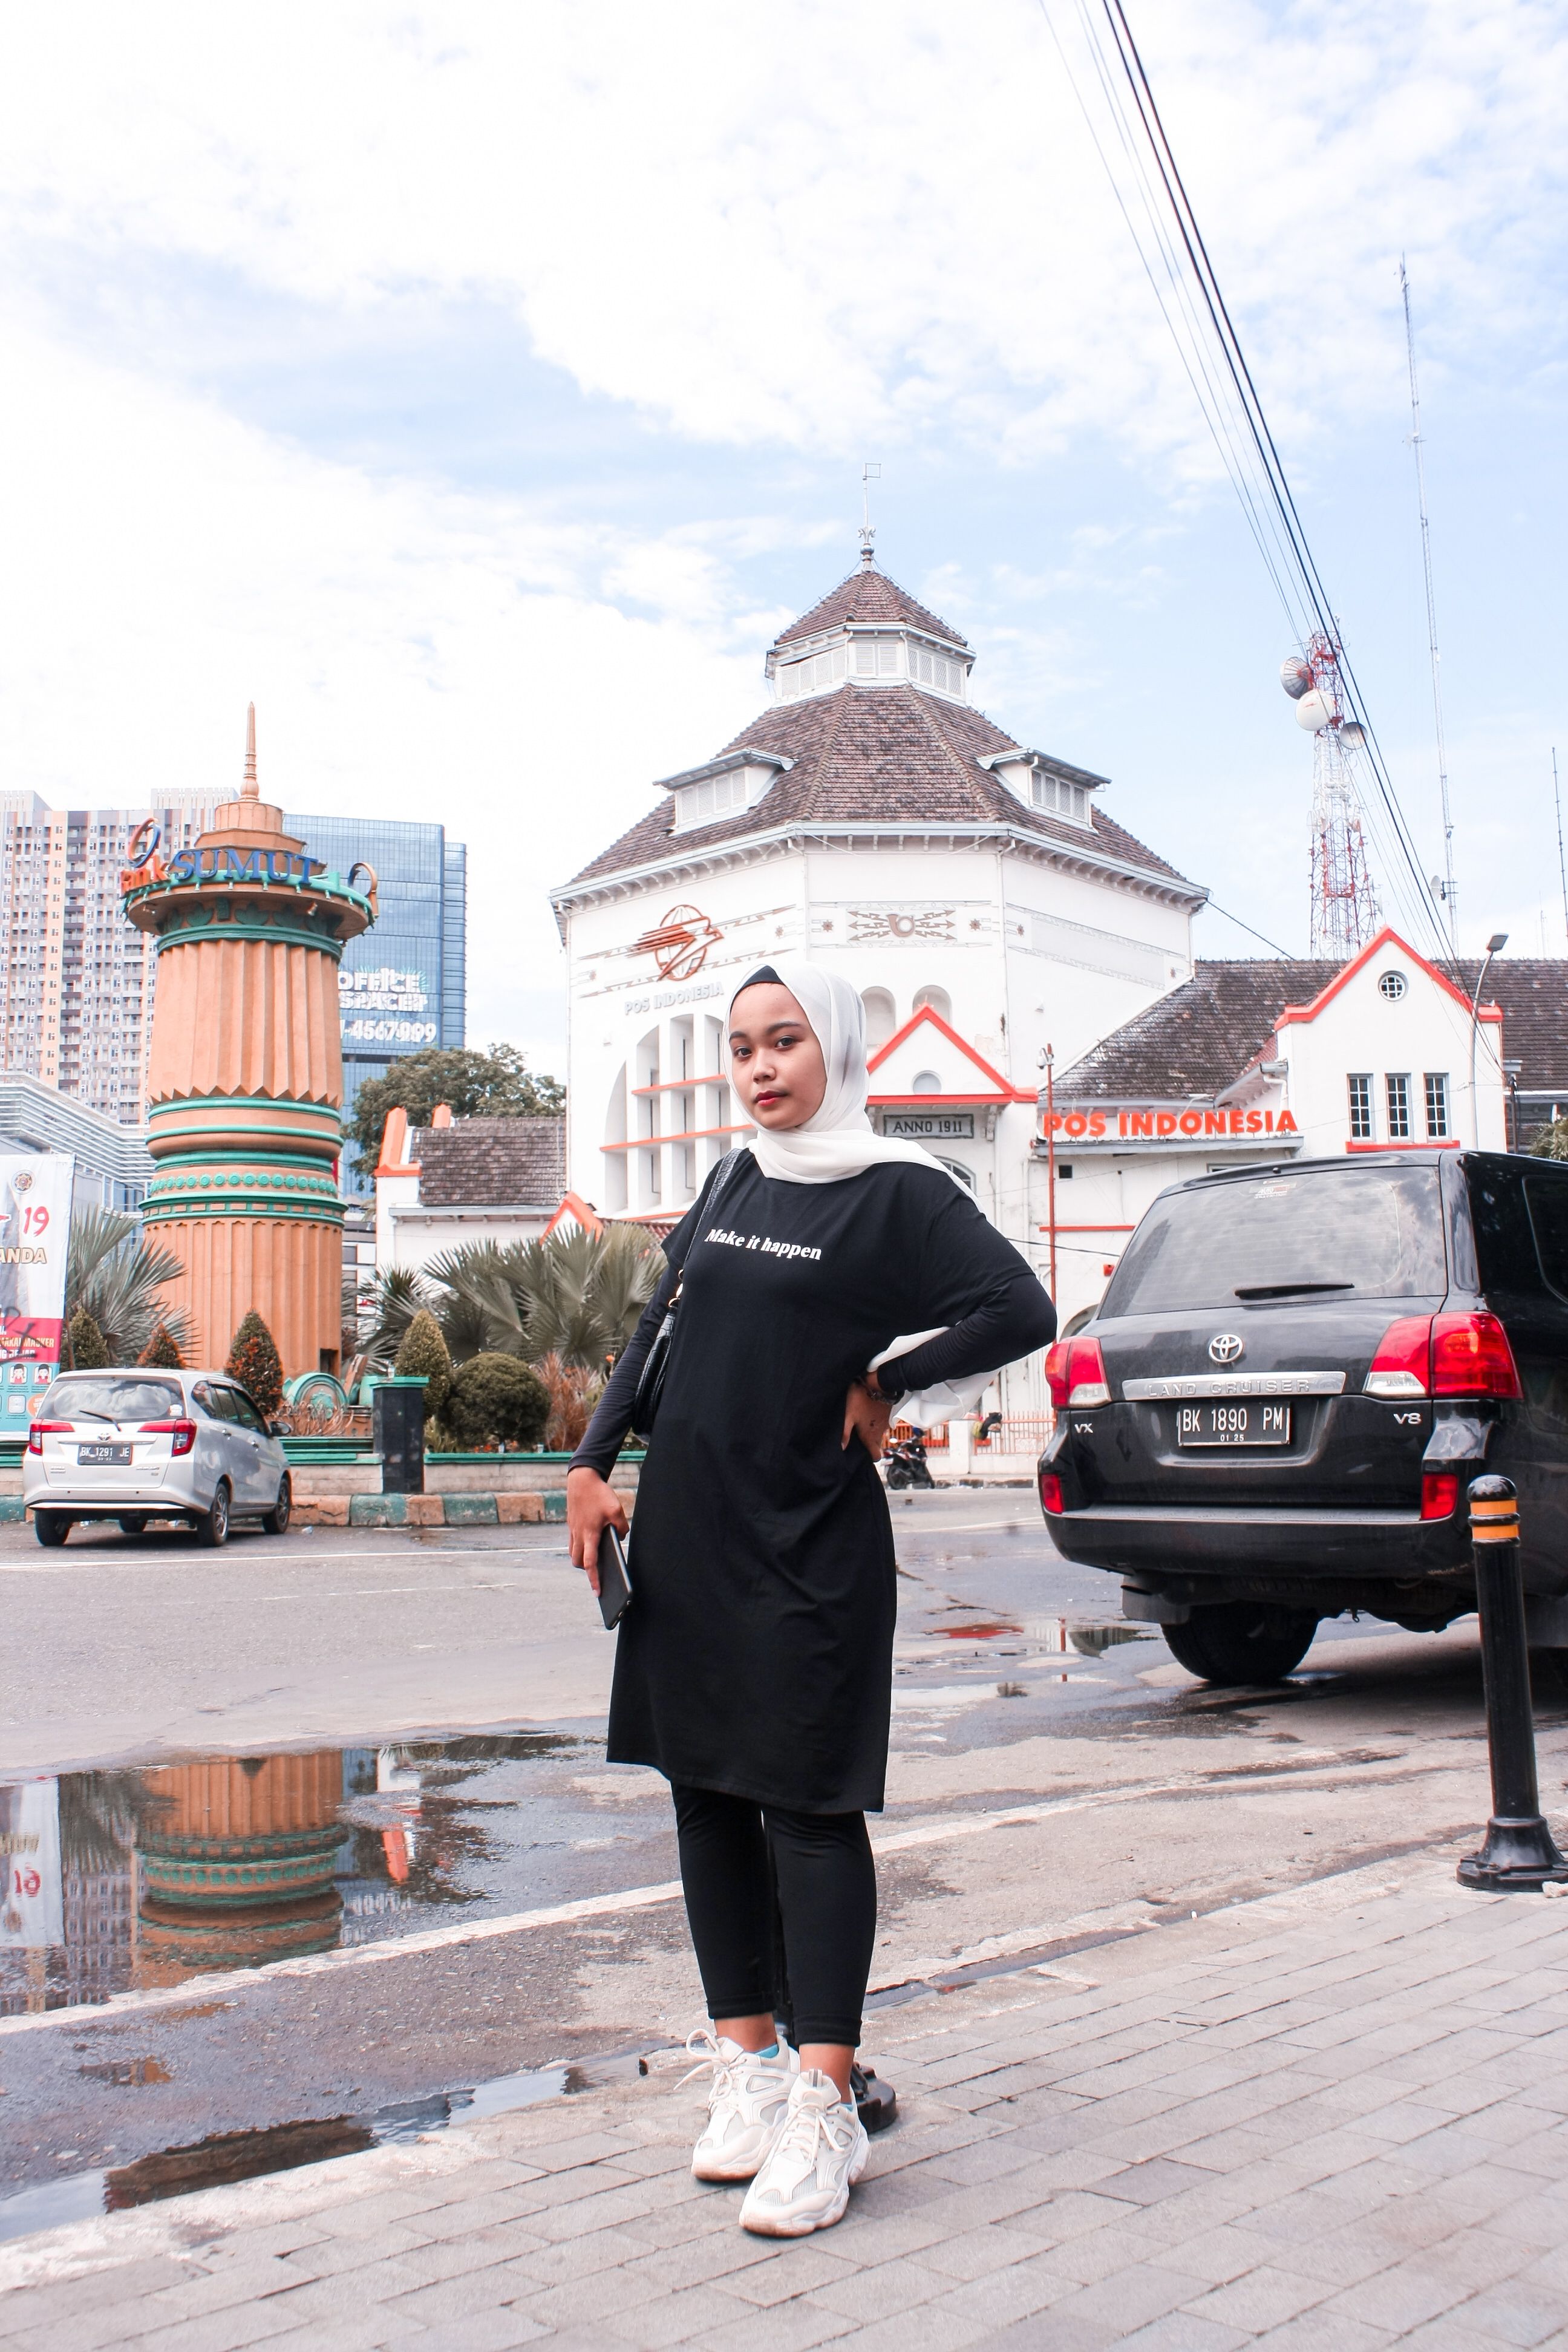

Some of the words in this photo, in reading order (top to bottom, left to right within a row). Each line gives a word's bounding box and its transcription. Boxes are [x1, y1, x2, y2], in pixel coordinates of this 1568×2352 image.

[172, 849, 319, 885] SUMUT
[338, 968, 421, 993] OFFICE
[625, 998, 650, 1015] POS
[654, 981, 724, 1009] INDONESIA
[893, 1121, 932, 1133] ANNO
[939, 1120, 962, 1132] 1911
[1042, 1112, 1106, 1137] POS
[1117, 1109, 1299, 1136] INDONESIA
[704, 1229, 745, 1247] Make
[745, 1235, 760, 1250] it
[760, 1237, 822, 1260] happen
[1149, 1383, 1197, 1397] LAND
[1210, 1379, 1310, 1394] CRUISER
[1074, 1423, 1093, 1433] VX
[1183, 1409, 1201, 1432] BK
[1211, 1408, 1247, 1431] 1890
[1263, 1407, 1283, 1430] PM
[1393, 1413, 1422, 1424] V8
[80, 1446, 91, 1457] BK
[96, 1446, 113, 1457] 1291
[120, 1446, 129, 1457] JE
